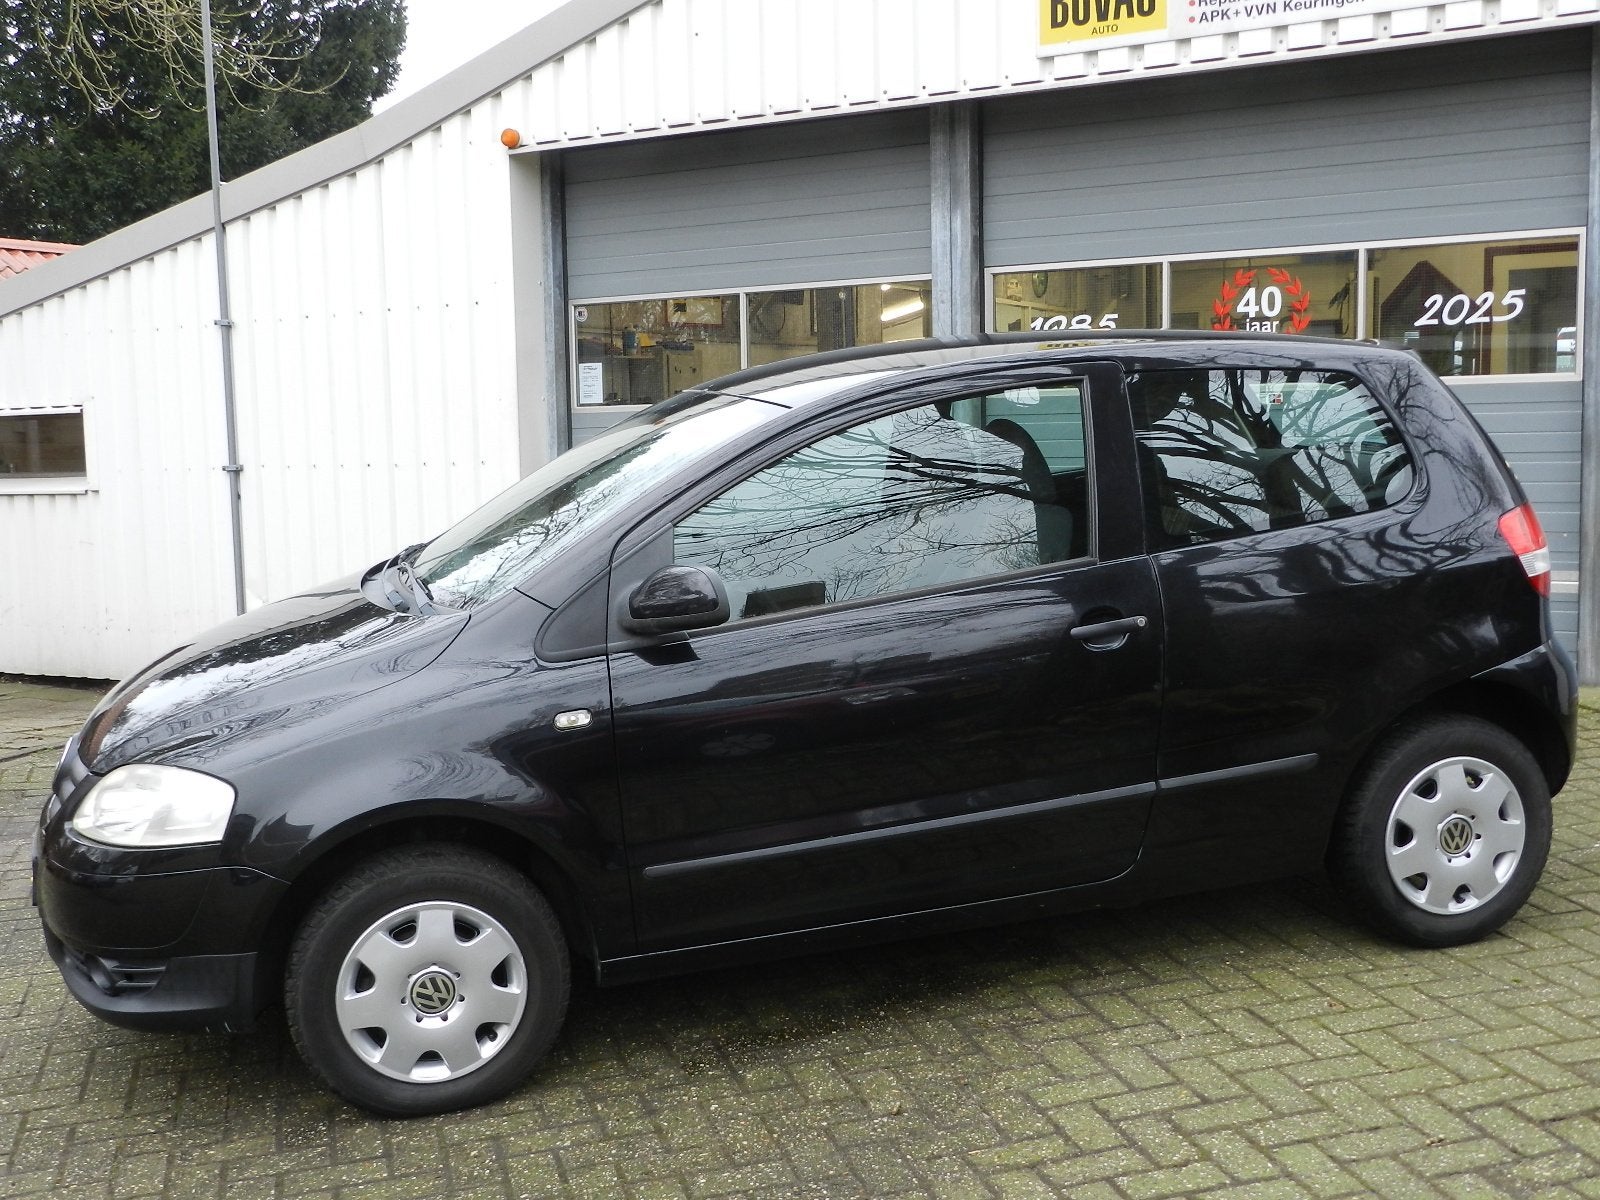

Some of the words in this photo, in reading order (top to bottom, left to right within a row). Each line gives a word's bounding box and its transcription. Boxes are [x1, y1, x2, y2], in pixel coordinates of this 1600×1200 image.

[1091, 24, 1119, 36] AUTO
[1236, 286, 1282, 318] 40
[1414, 288, 1527, 327] 2025
[1442, 820, 1471, 852] VW
